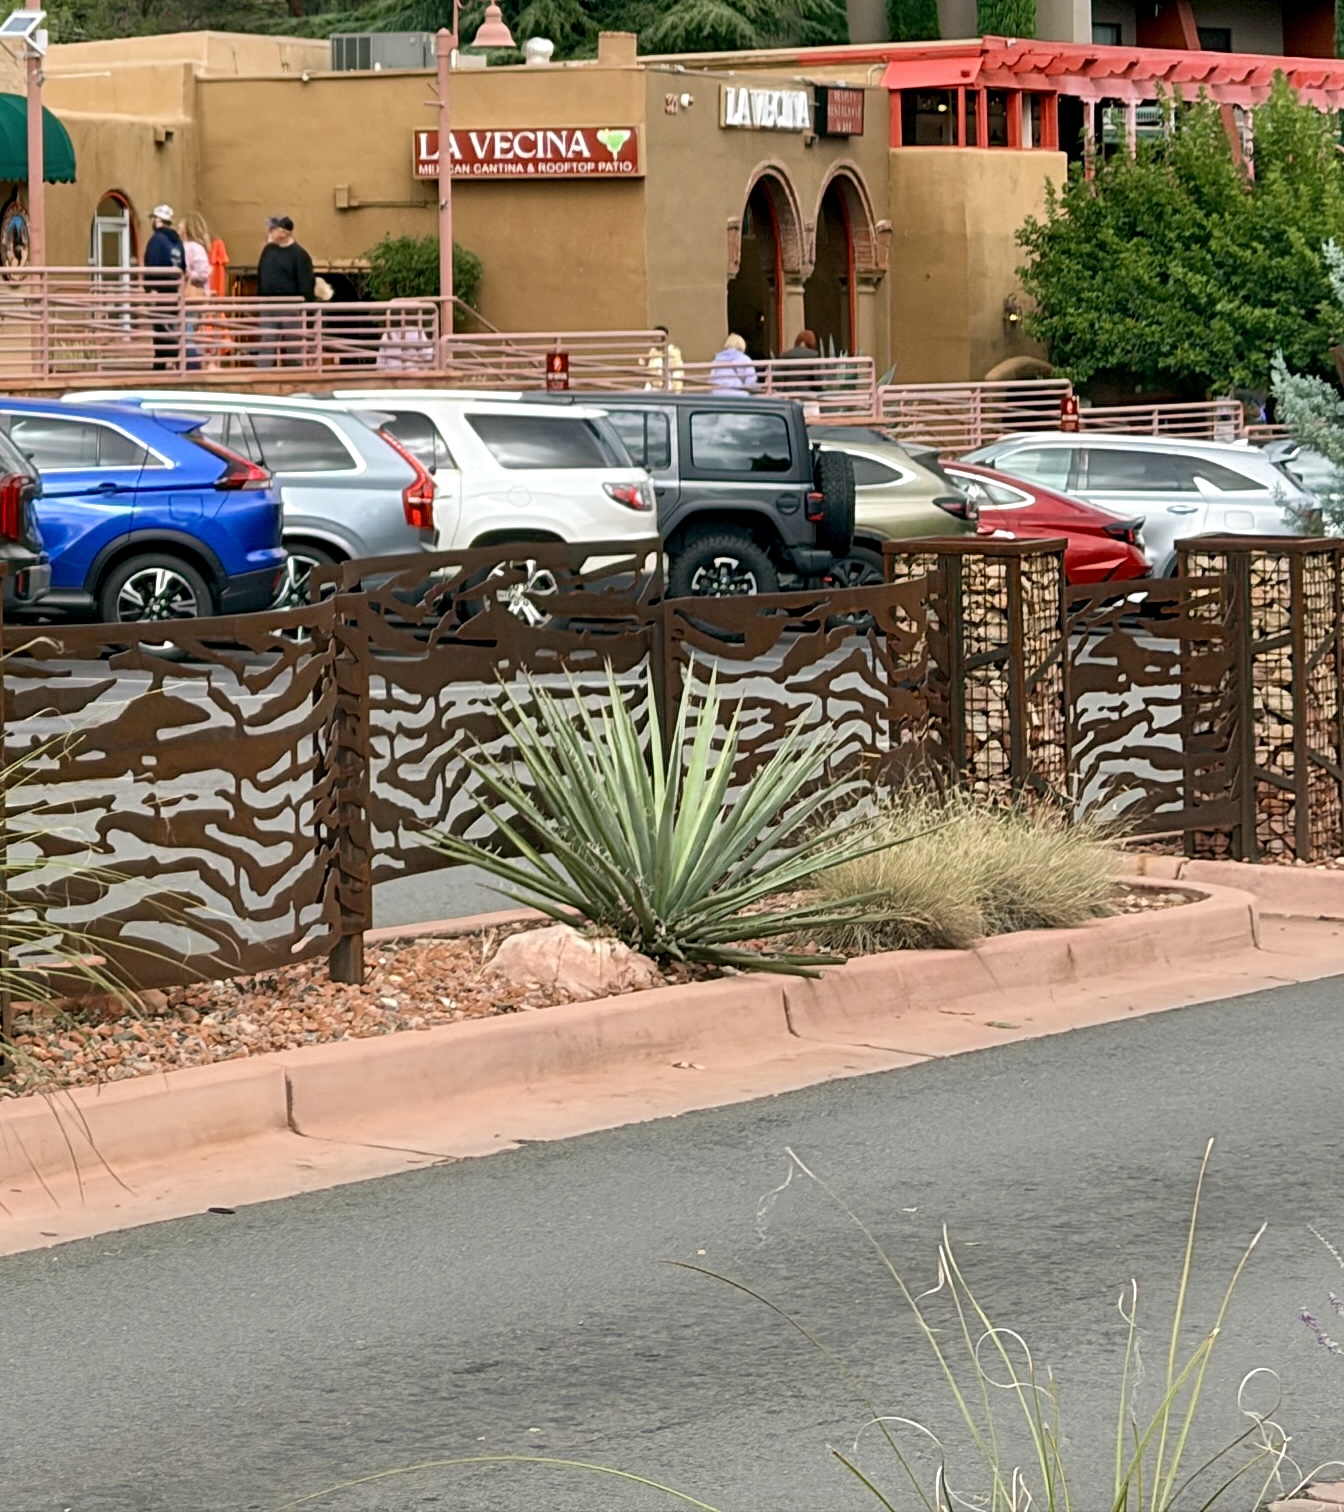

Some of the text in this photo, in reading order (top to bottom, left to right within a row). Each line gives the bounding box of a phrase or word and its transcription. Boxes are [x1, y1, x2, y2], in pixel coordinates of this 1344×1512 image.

[469, 130, 591, 160] VECINA
[474, 162, 525, 174] CANTINA
[526, 162, 536, 173] &
[538, 161, 595, 173] ROOFTOP
[598, 160, 633, 173] PATIO
